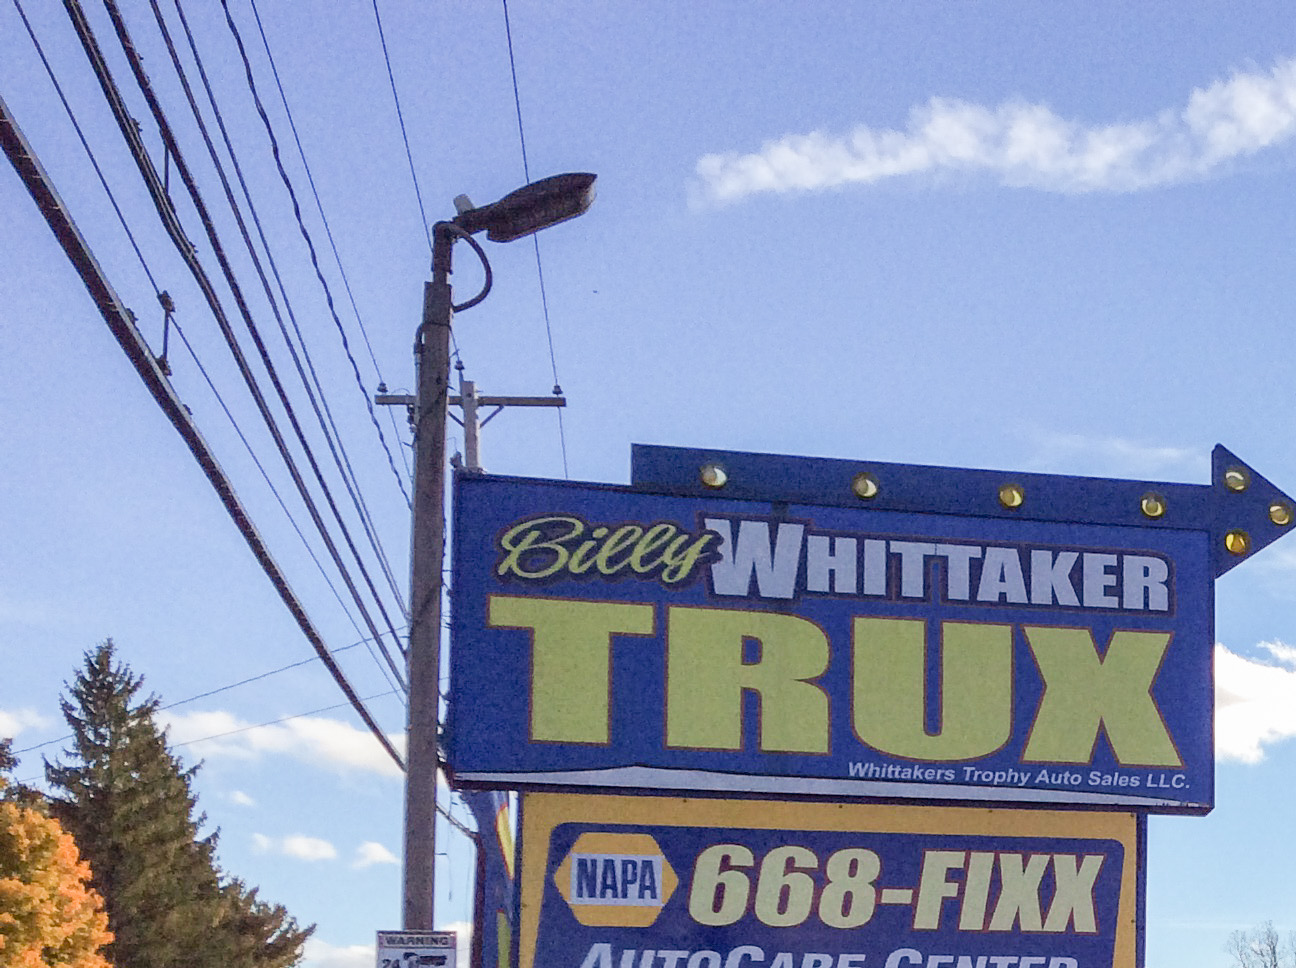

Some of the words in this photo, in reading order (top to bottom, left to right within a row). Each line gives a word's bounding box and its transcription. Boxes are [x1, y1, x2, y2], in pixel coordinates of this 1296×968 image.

[498, 516, 713, 584] Billy
[704, 517, 1170, 612] WHITTAKER
[488, 596, 1185, 769] TRUX
[848, 762, 956, 781] Whittakers
[962, 766, 1033, 787] Trophy
[1034, 769, 1083, 786] Auto
[1087, 771, 1141, 788] Sales
[1146, 773, 1191, 789] LLC.
[576, 856, 659, 902] NAPA
[688, 843, 1106, 934] 668-FIXX
[385, 936, 449, 946] WARNING
